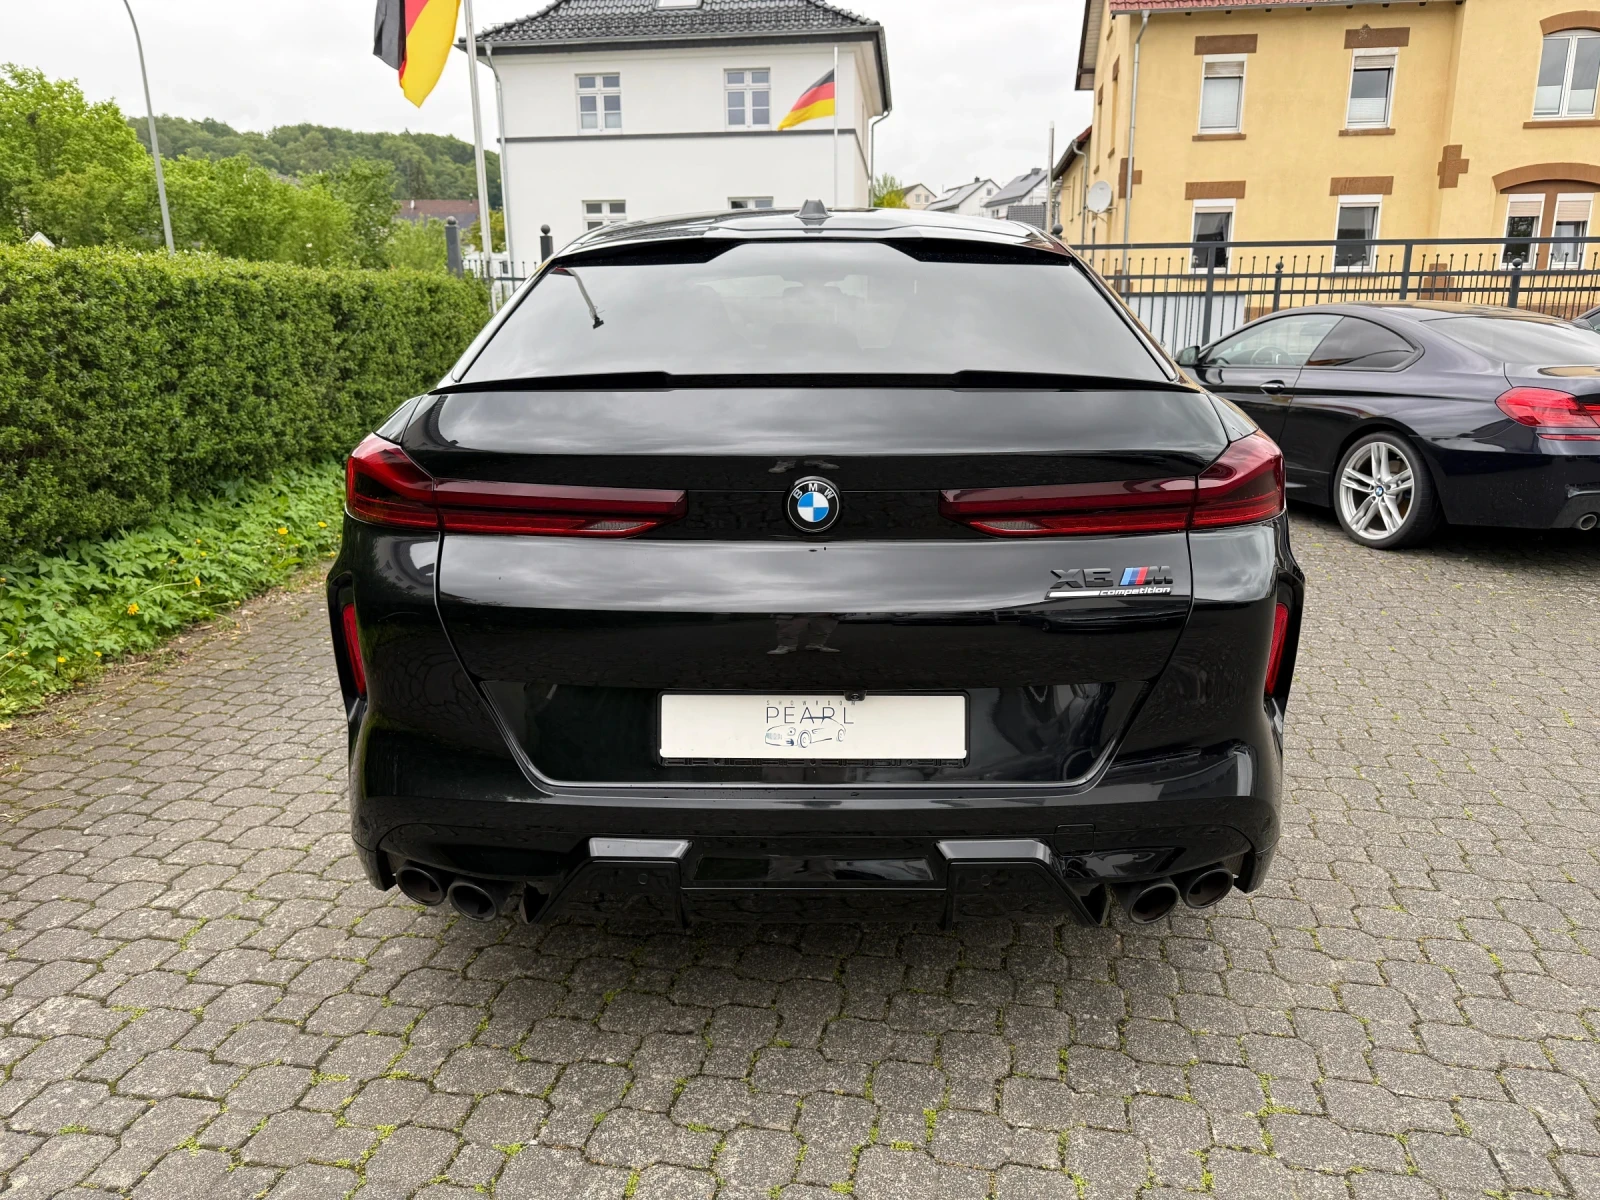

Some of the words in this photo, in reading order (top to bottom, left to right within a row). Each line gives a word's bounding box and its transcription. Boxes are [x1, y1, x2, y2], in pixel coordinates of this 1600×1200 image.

[793, 483, 835, 500] BMW
[1050, 568, 1114, 589] X6
[1099, 586, 1171, 597] competition
[766, 706, 854, 724] PEARL
